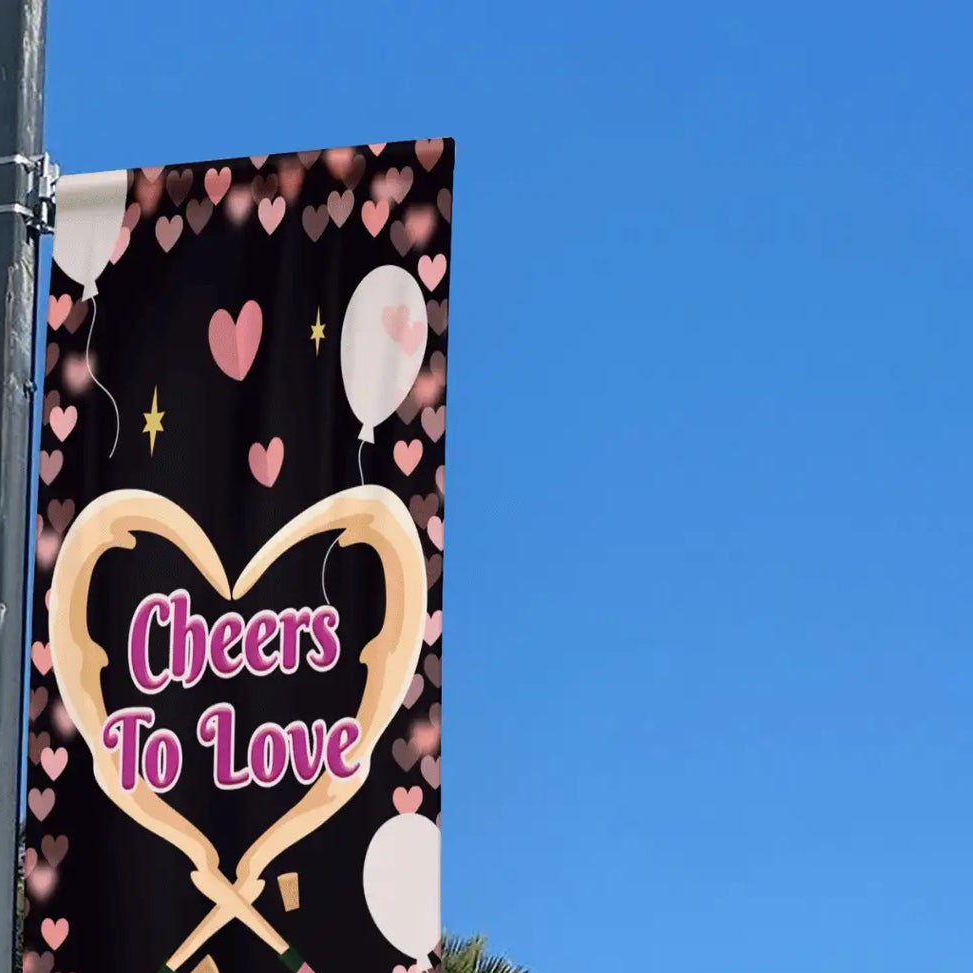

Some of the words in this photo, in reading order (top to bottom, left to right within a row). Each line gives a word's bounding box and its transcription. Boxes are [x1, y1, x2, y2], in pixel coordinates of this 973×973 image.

[128, 588, 340, 694] Cheers
[102, 705, 182, 793] To
[197, 702, 361, 790] Love
